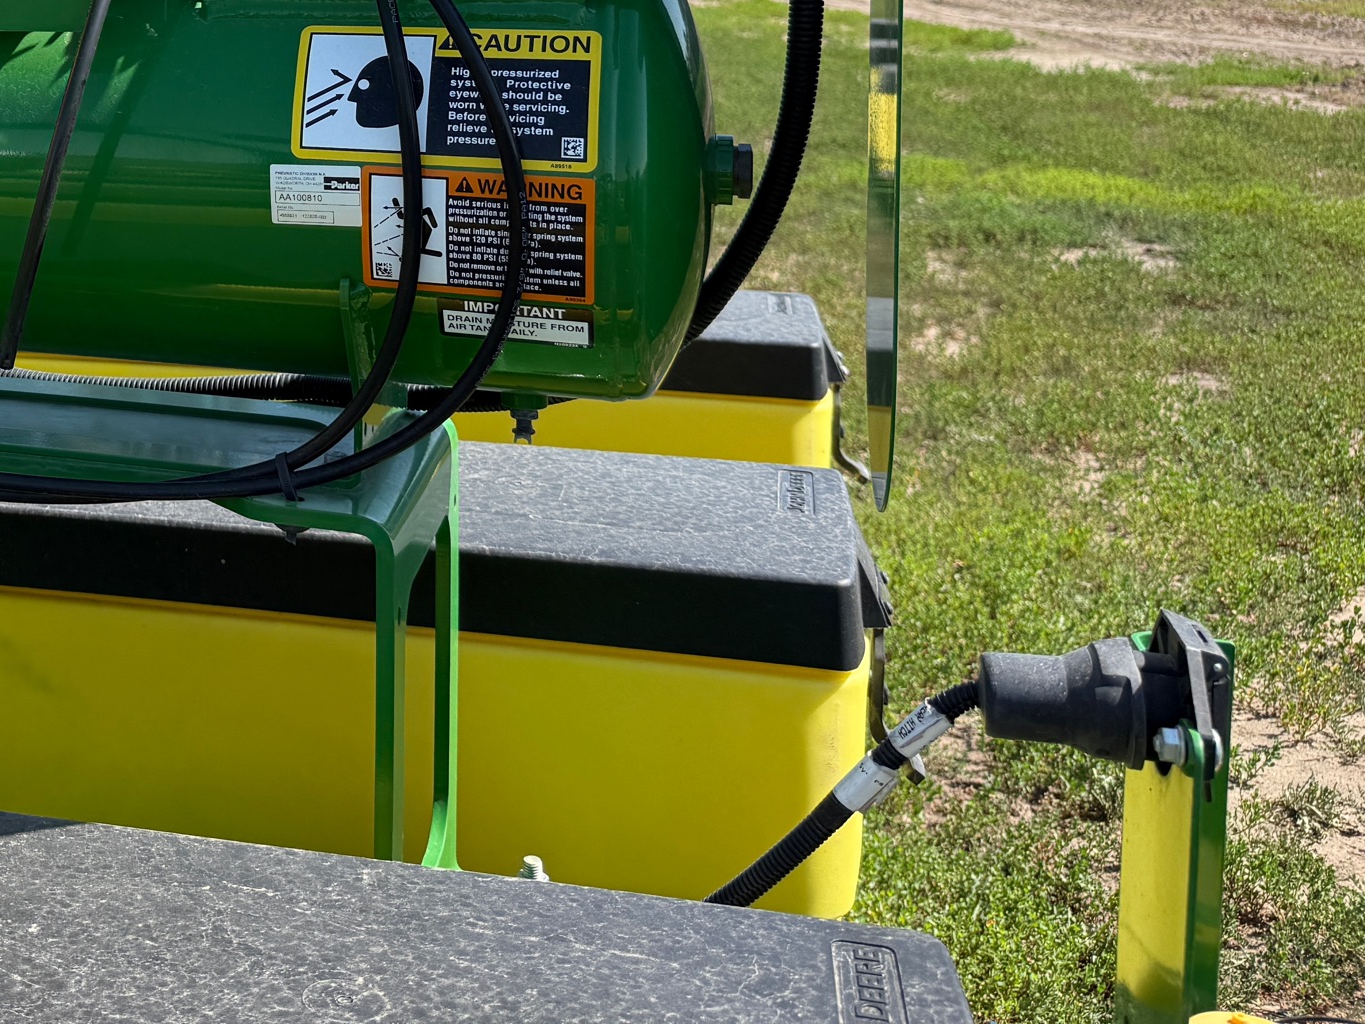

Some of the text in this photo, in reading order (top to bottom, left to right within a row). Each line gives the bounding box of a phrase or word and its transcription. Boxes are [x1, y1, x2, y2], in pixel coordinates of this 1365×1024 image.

[451, 67, 559, 78] Hig pressurized
[506, 79, 571, 90] Protective
[502, 91, 543, 100] should
[547, 91, 562, 101] be
[449, 102, 476, 110] worn
[513, 102, 570, 115] servicing.
[448, 111, 487, 121] Before
[447, 123, 487, 133] relieve
[512, 126, 554, 137] system
[330, 180, 359, 190] Parker
[477, 178, 583, 200] WANING
[278, 193, 323, 202] AA100810
[448, 198, 470, 207] Avoid
[472, 200, 501, 209] serious
[529, 204, 548, 212] from
[448, 208, 497, 217] pressurization
[544, 213, 555, 221] the
[557, 215, 583, 224] system
[448, 216, 477, 224] without
[549, 222, 573, 231] place.
[472, 228, 495, 236] inflate
[532, 233, 556, 242] spring
[557, 234, 583, 242] system
[487, 237, 501, 245] PSI
[474, 246, 498, 254] inflate
[530, 251, 554, 259] spring
[556, 252, 583, 261] system
[483, 254, 496, 262] PSI
[449, 260, 458, 268] Do
[449, 278, 493, 288] components
[523, 283, 542, 291] lace.
[543, 278, 568, 286] unless
[447, 314, 585, 333] DRAIN MTURE FROM
[448, 322, 538, 337] AIR TAN AILY.
[897, 718, 916, 739] HITCH
[853, 948, 890, 1023] DEERE
